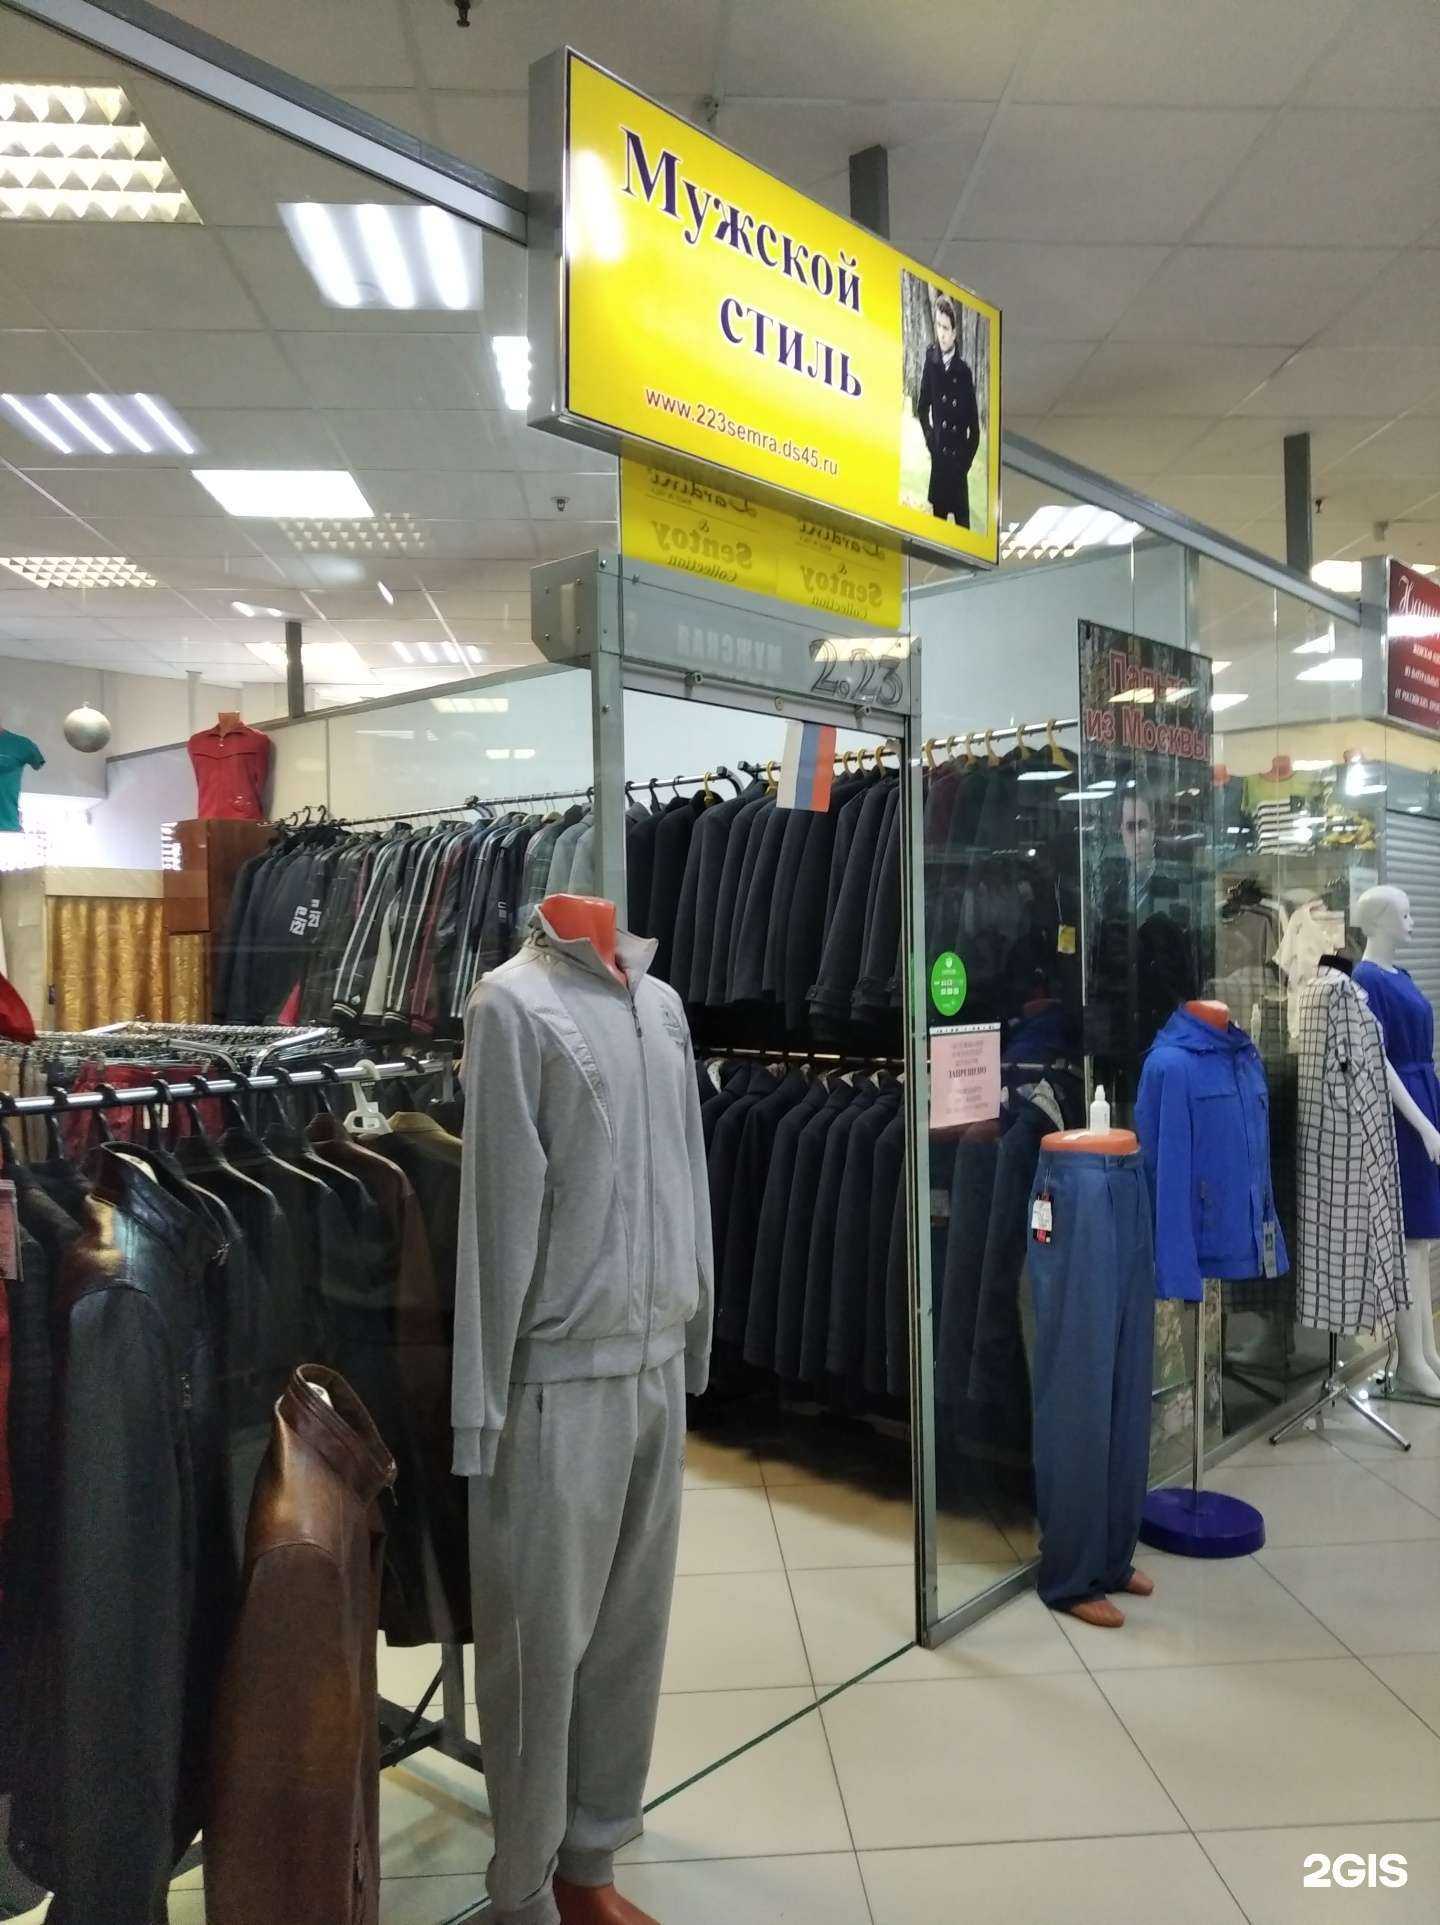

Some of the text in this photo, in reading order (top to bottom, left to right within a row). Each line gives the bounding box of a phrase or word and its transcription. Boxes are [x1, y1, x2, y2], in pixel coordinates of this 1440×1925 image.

[620, 126, 861, 313] Мужской
[720, 297, 863, 398] стиль
[645, 388, 839, 477] www.223semra.ds45.ru
[1122, 706, 1211, 763] Москвы
